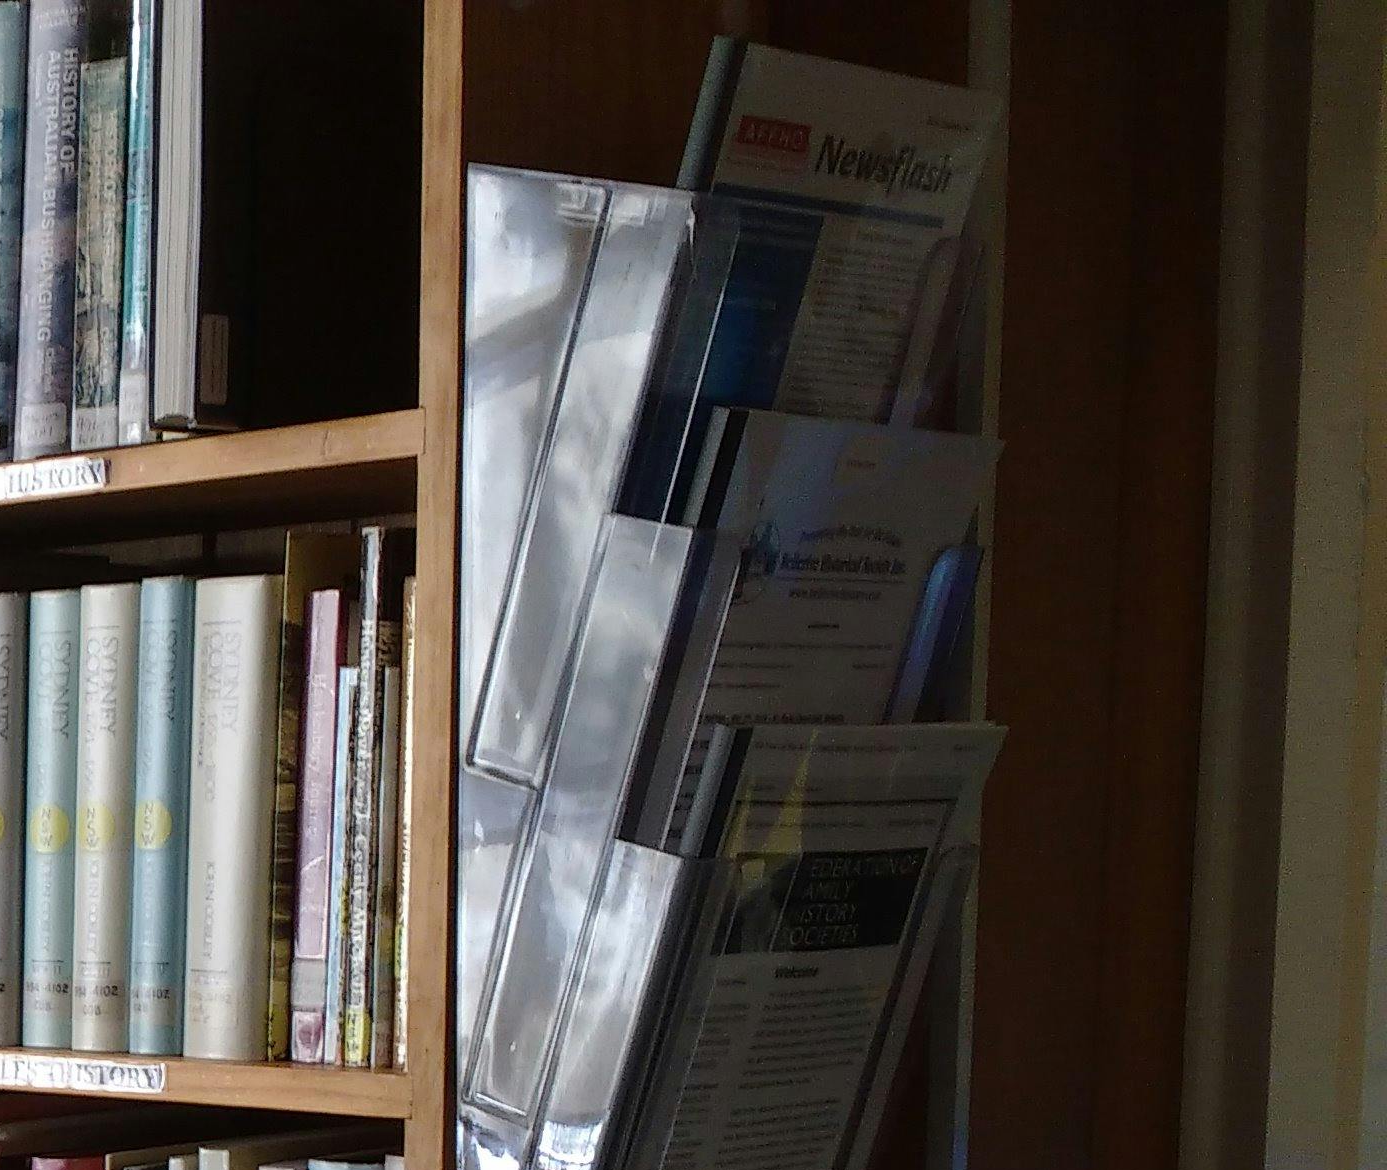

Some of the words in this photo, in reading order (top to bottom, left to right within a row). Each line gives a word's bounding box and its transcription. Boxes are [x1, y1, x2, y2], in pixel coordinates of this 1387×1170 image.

[43, 49, 61, 181] AUSTRALIAN
[60, 48, 78, 140] HISTORY
[60, 148, 76, 175] OF
[815, 135, 952, 197] Newsflash
[7, 460, 104, 496] HISTORY
[209, 630, 220, 701] COVE
[221, 633, 241, 734] SYDNEY
